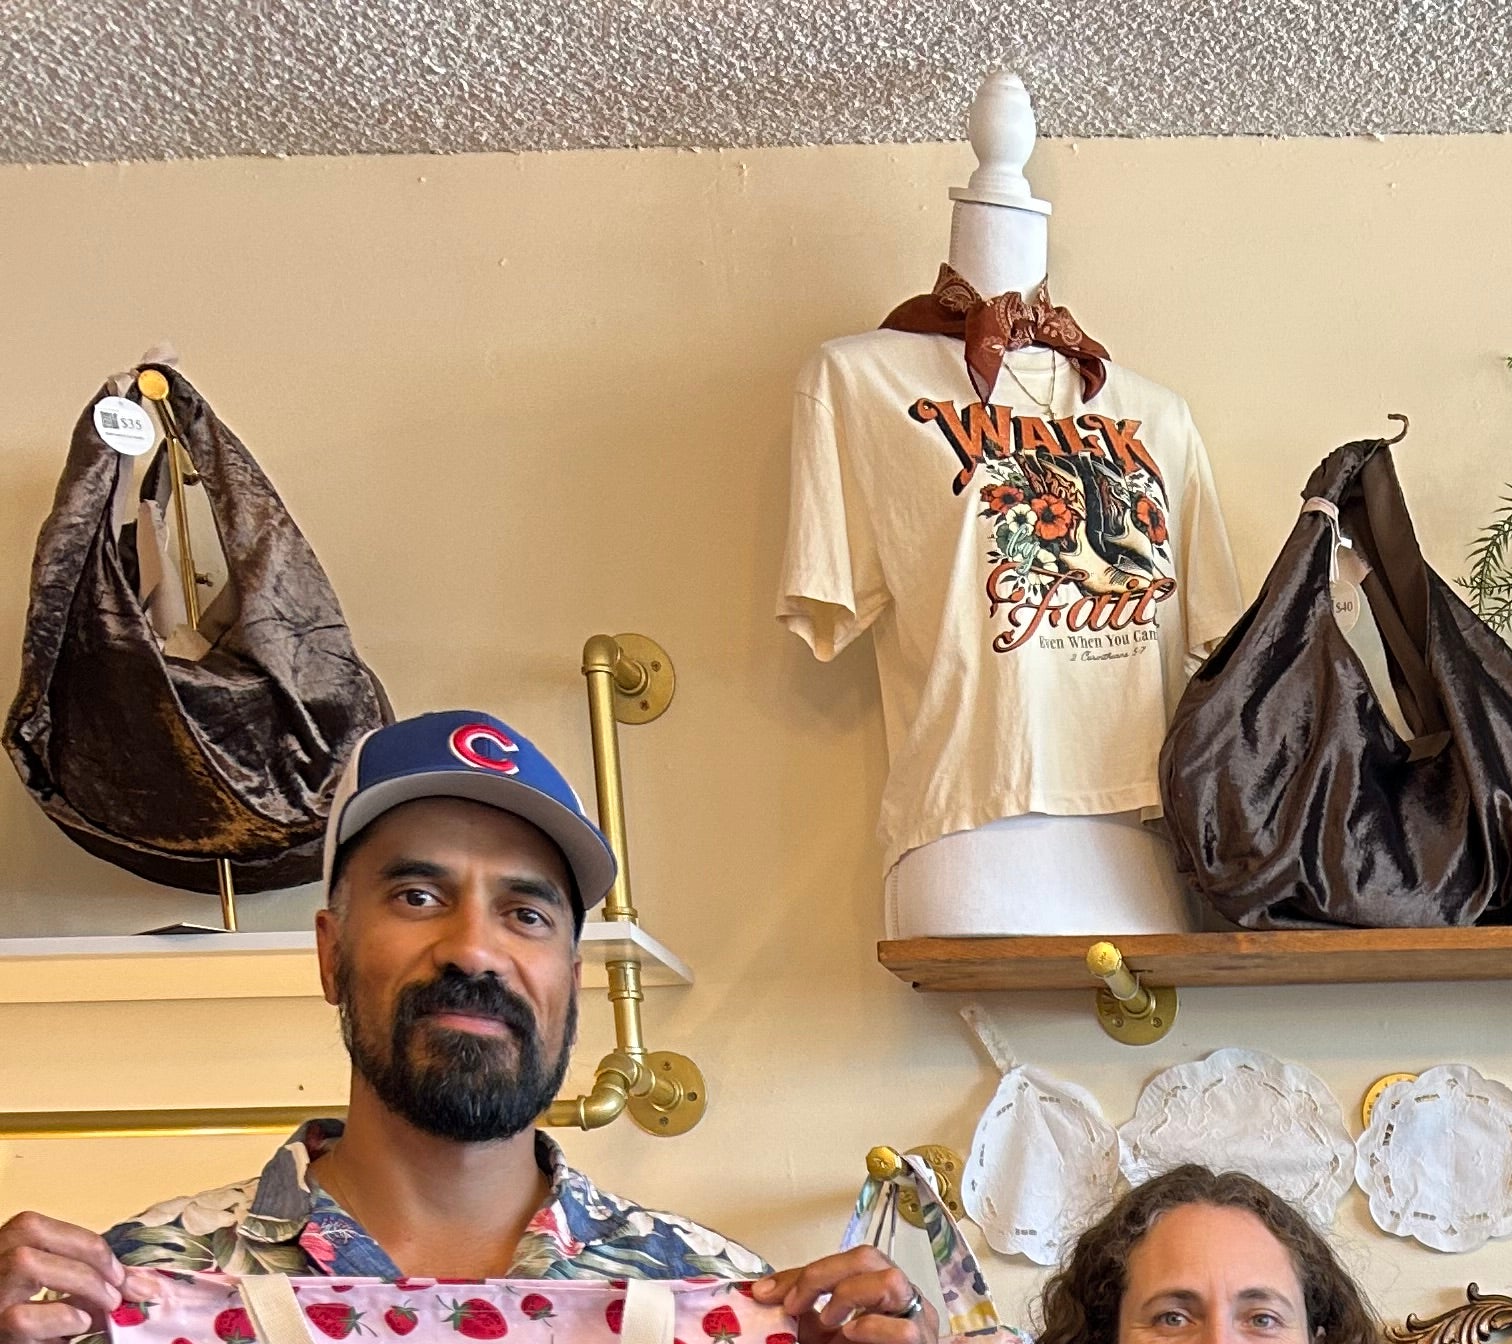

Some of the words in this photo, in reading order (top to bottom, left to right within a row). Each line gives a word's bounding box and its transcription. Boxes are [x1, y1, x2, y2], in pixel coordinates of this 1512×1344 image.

[908, 398, 1170, 512] WALK
[1335, 601, 1353, 613] $40
[1039, 635, 1065, 649] Even
[1067, 635, 1103, 649] When
[1105, 634, 1130, 647] You
[449, 723, 520, 776] C
